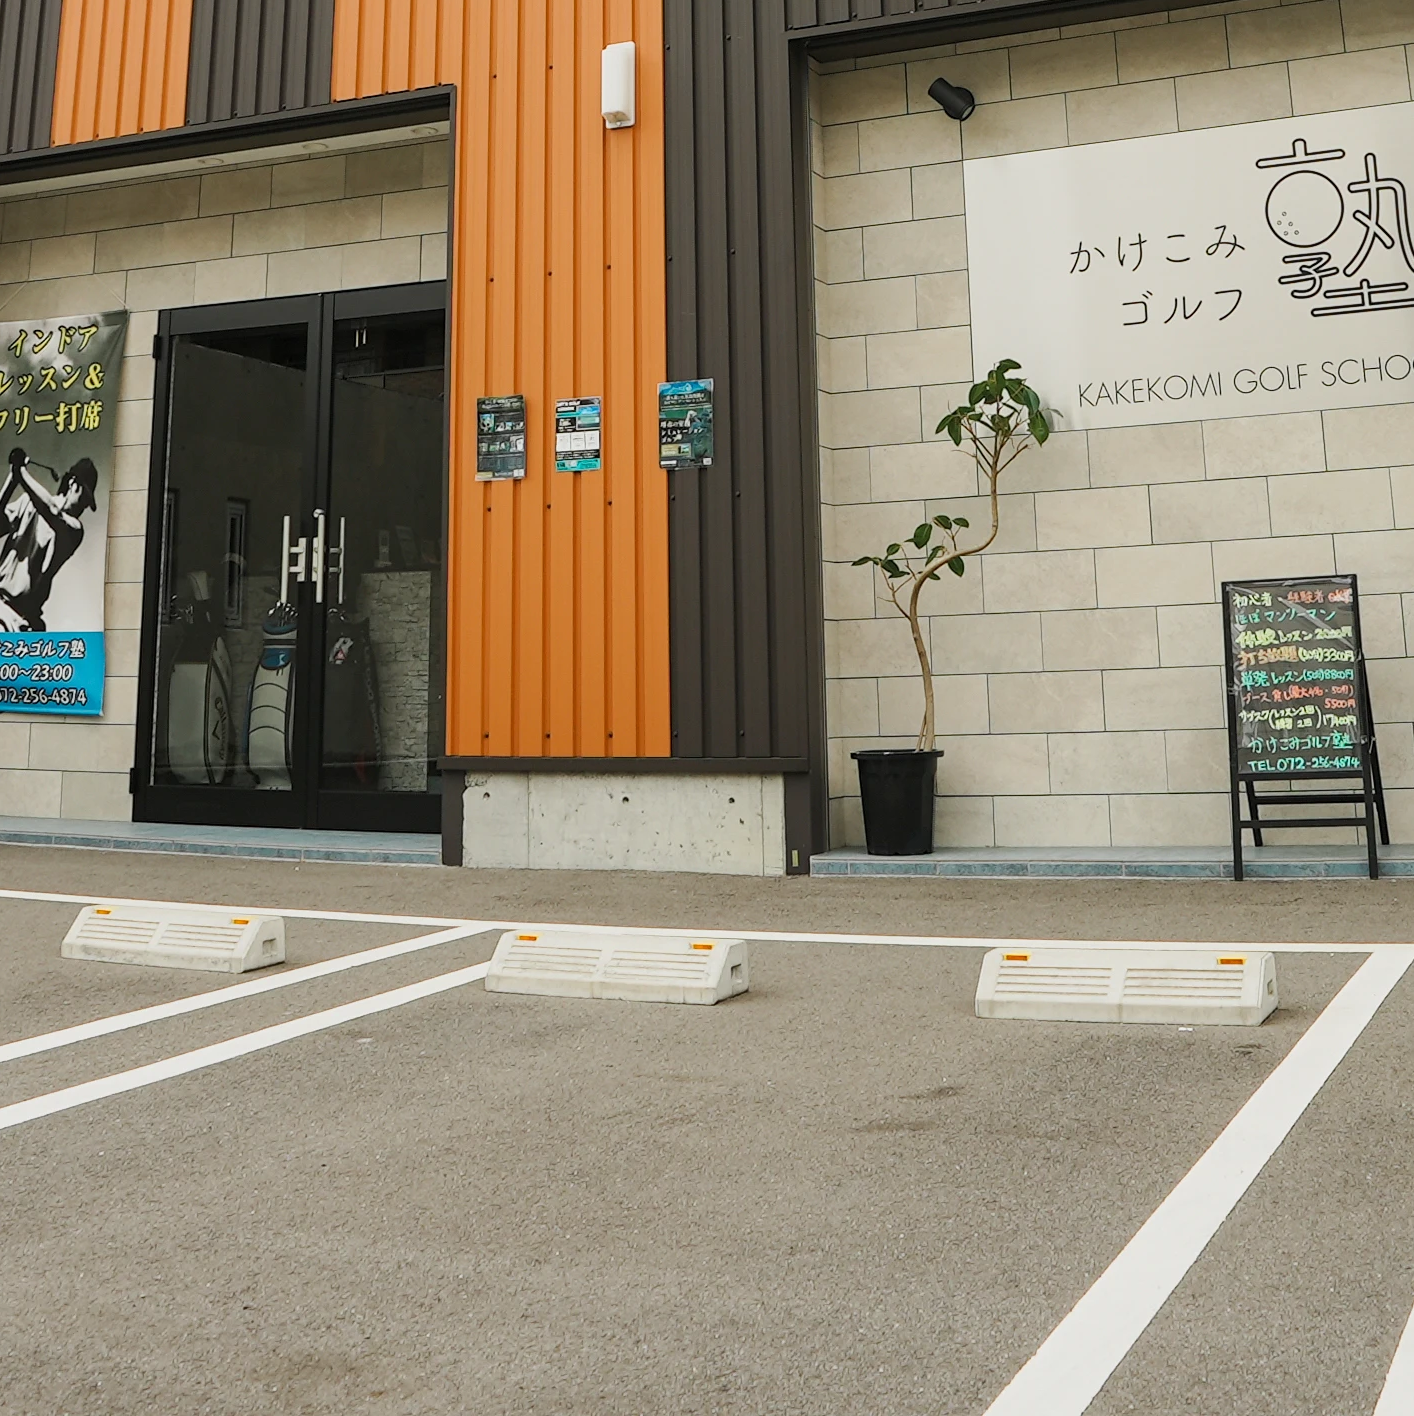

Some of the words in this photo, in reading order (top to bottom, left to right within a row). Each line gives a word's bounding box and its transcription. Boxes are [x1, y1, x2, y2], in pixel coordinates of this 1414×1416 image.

[1069, 224, 1246, 275] かけこみ
[1122, 288, 1244, 326] ゴルフ
[7, 324, 99, 359] インドア
[1077, 371, 1223, 408] KAKEKOMI
[1233, 363, 1307, 396] GOLF
